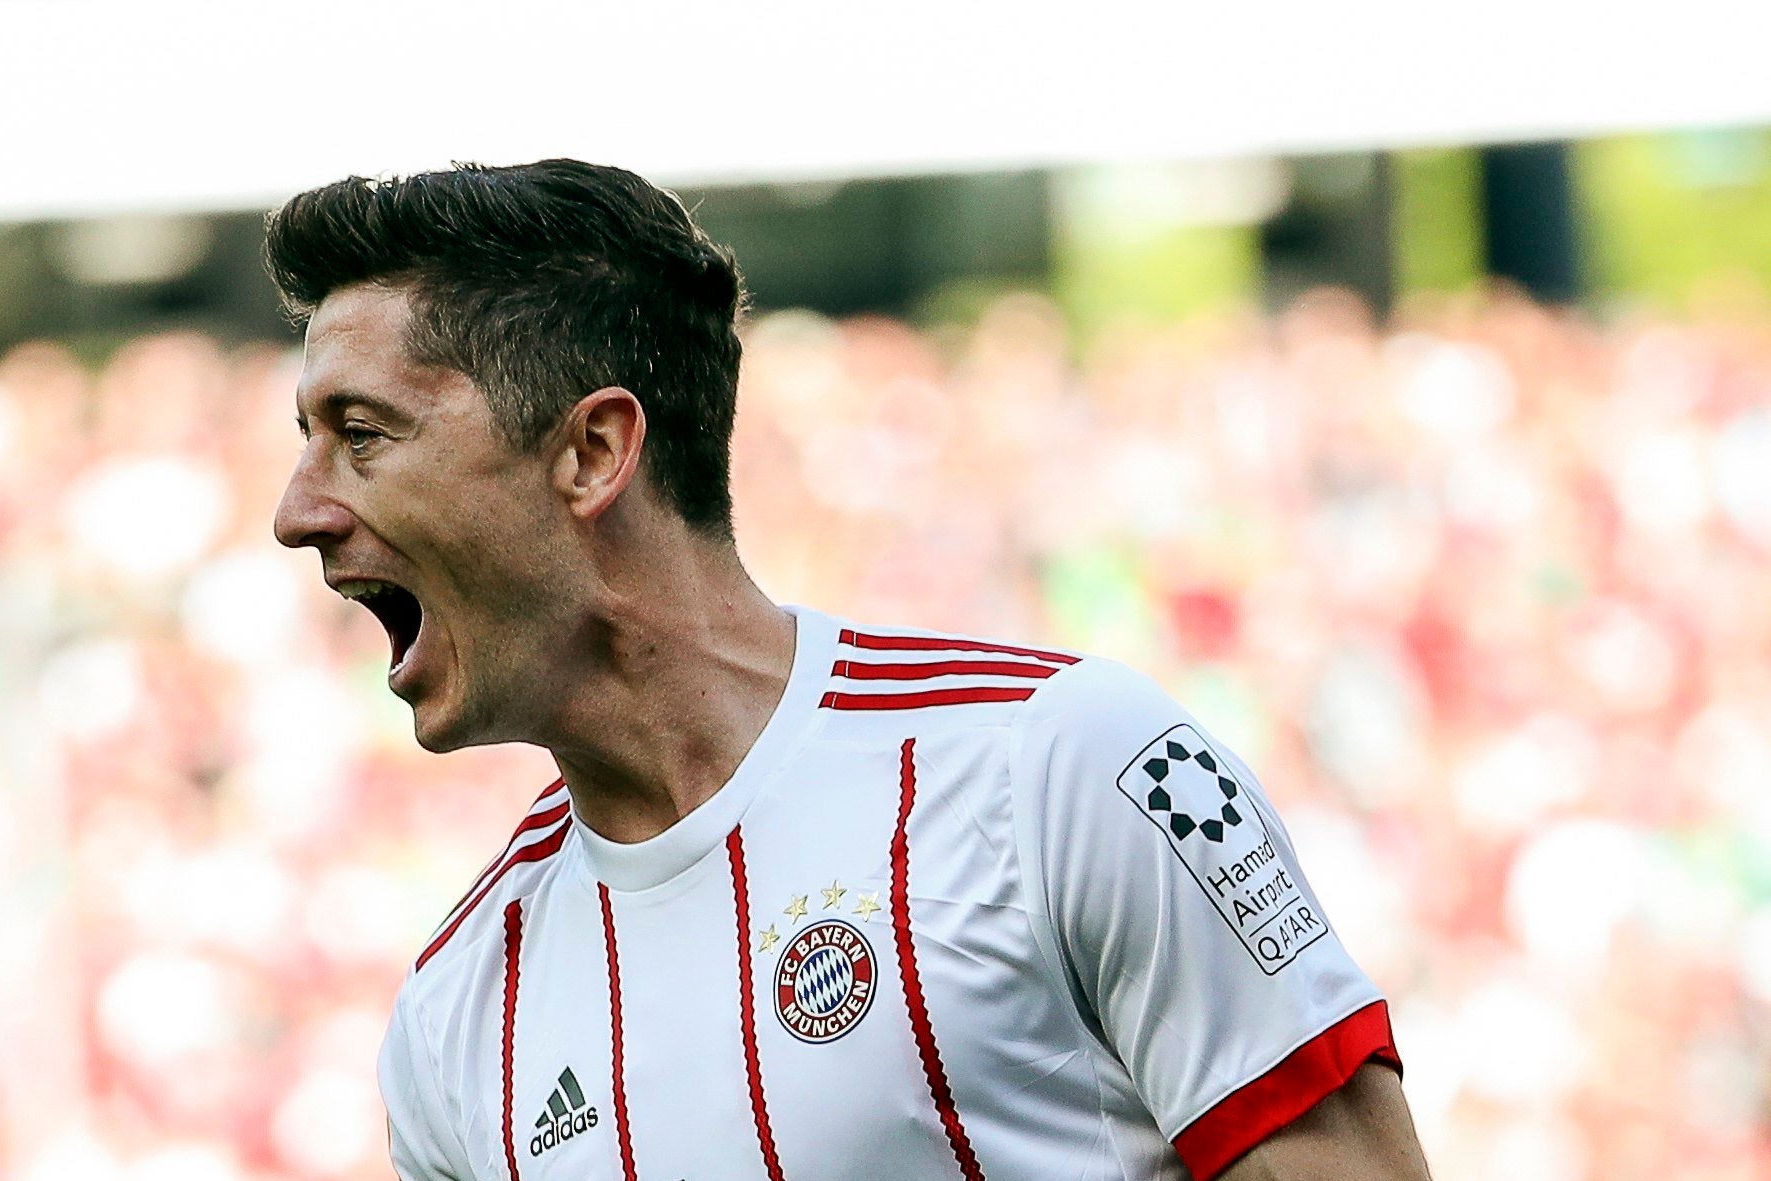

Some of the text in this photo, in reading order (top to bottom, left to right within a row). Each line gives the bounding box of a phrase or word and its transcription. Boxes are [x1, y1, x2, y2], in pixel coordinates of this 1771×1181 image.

[1207, 833, 1275, 898] Hamd
[780, 926, 866, 986] FC BAYERN
[1258, 907, 1319, 961] QAAR
[530, 1106, 599, 1157] adidas
